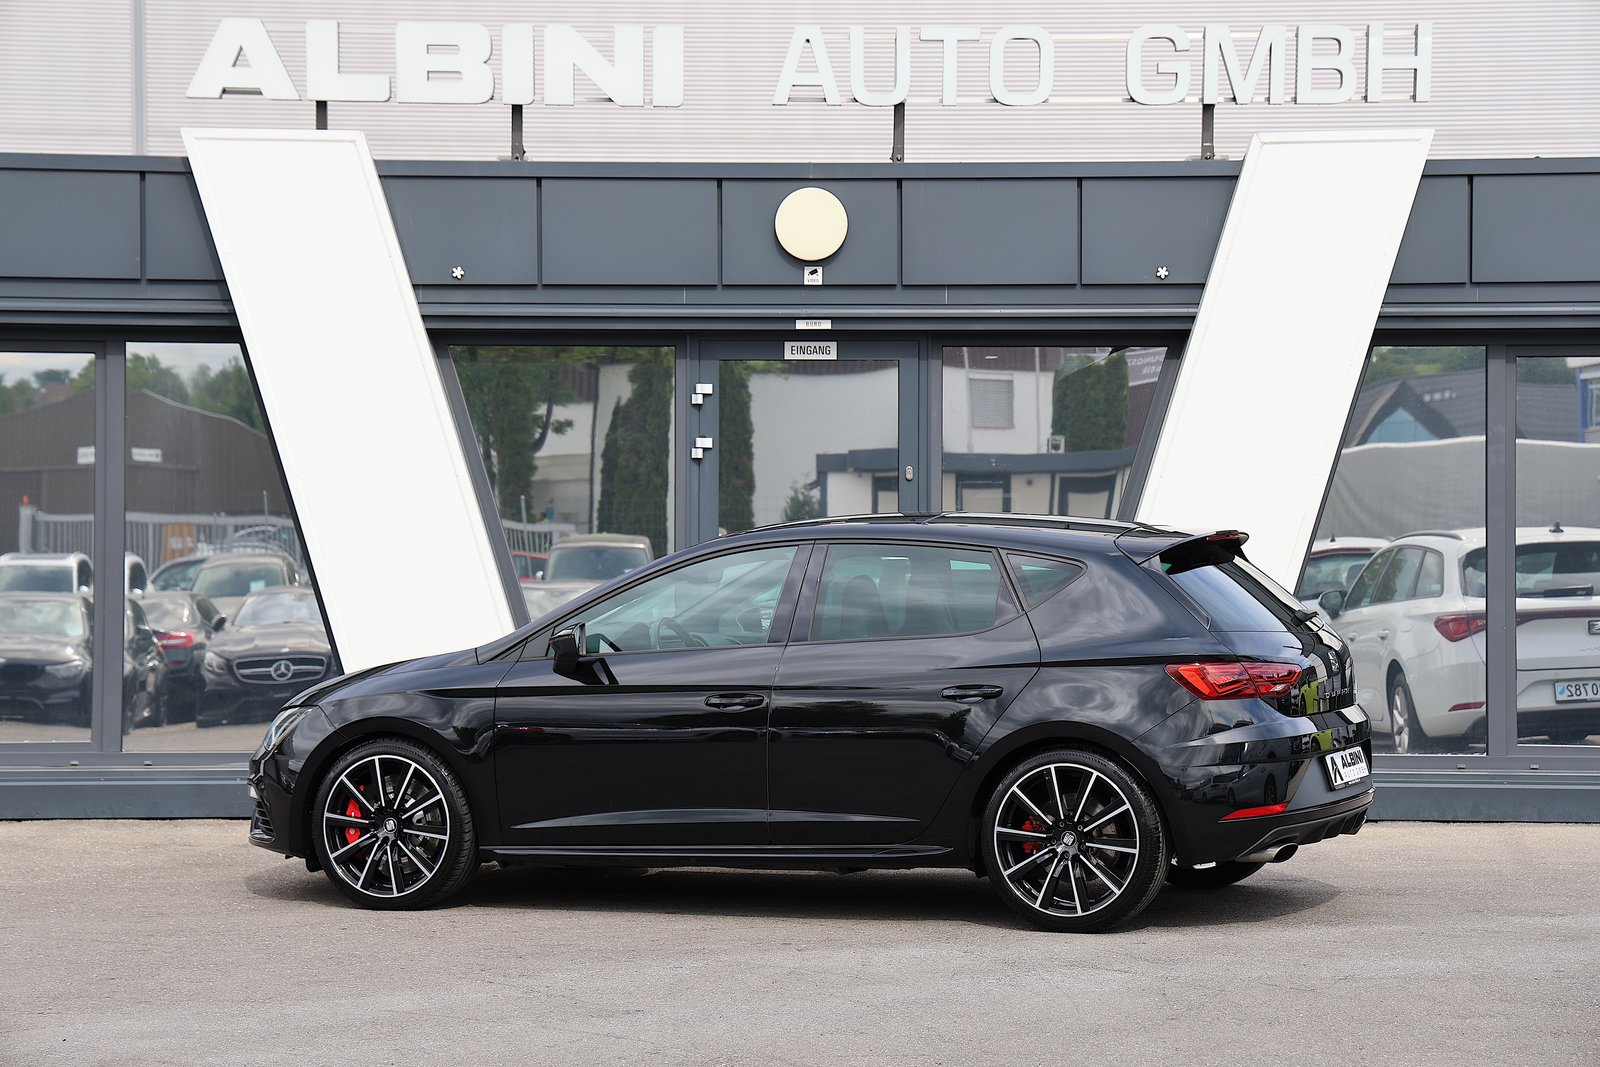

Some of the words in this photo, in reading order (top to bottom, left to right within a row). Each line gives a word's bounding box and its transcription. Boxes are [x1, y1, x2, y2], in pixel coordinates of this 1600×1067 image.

[186, 17, 685, 107] ALBINI
[772, 24, 1055, 106] AUTO
[1124, 22, 1432, 105] GMBH
[790, 345, 831, 355] EINGANG
[1341, 750, 1363, 769] ALBINI
